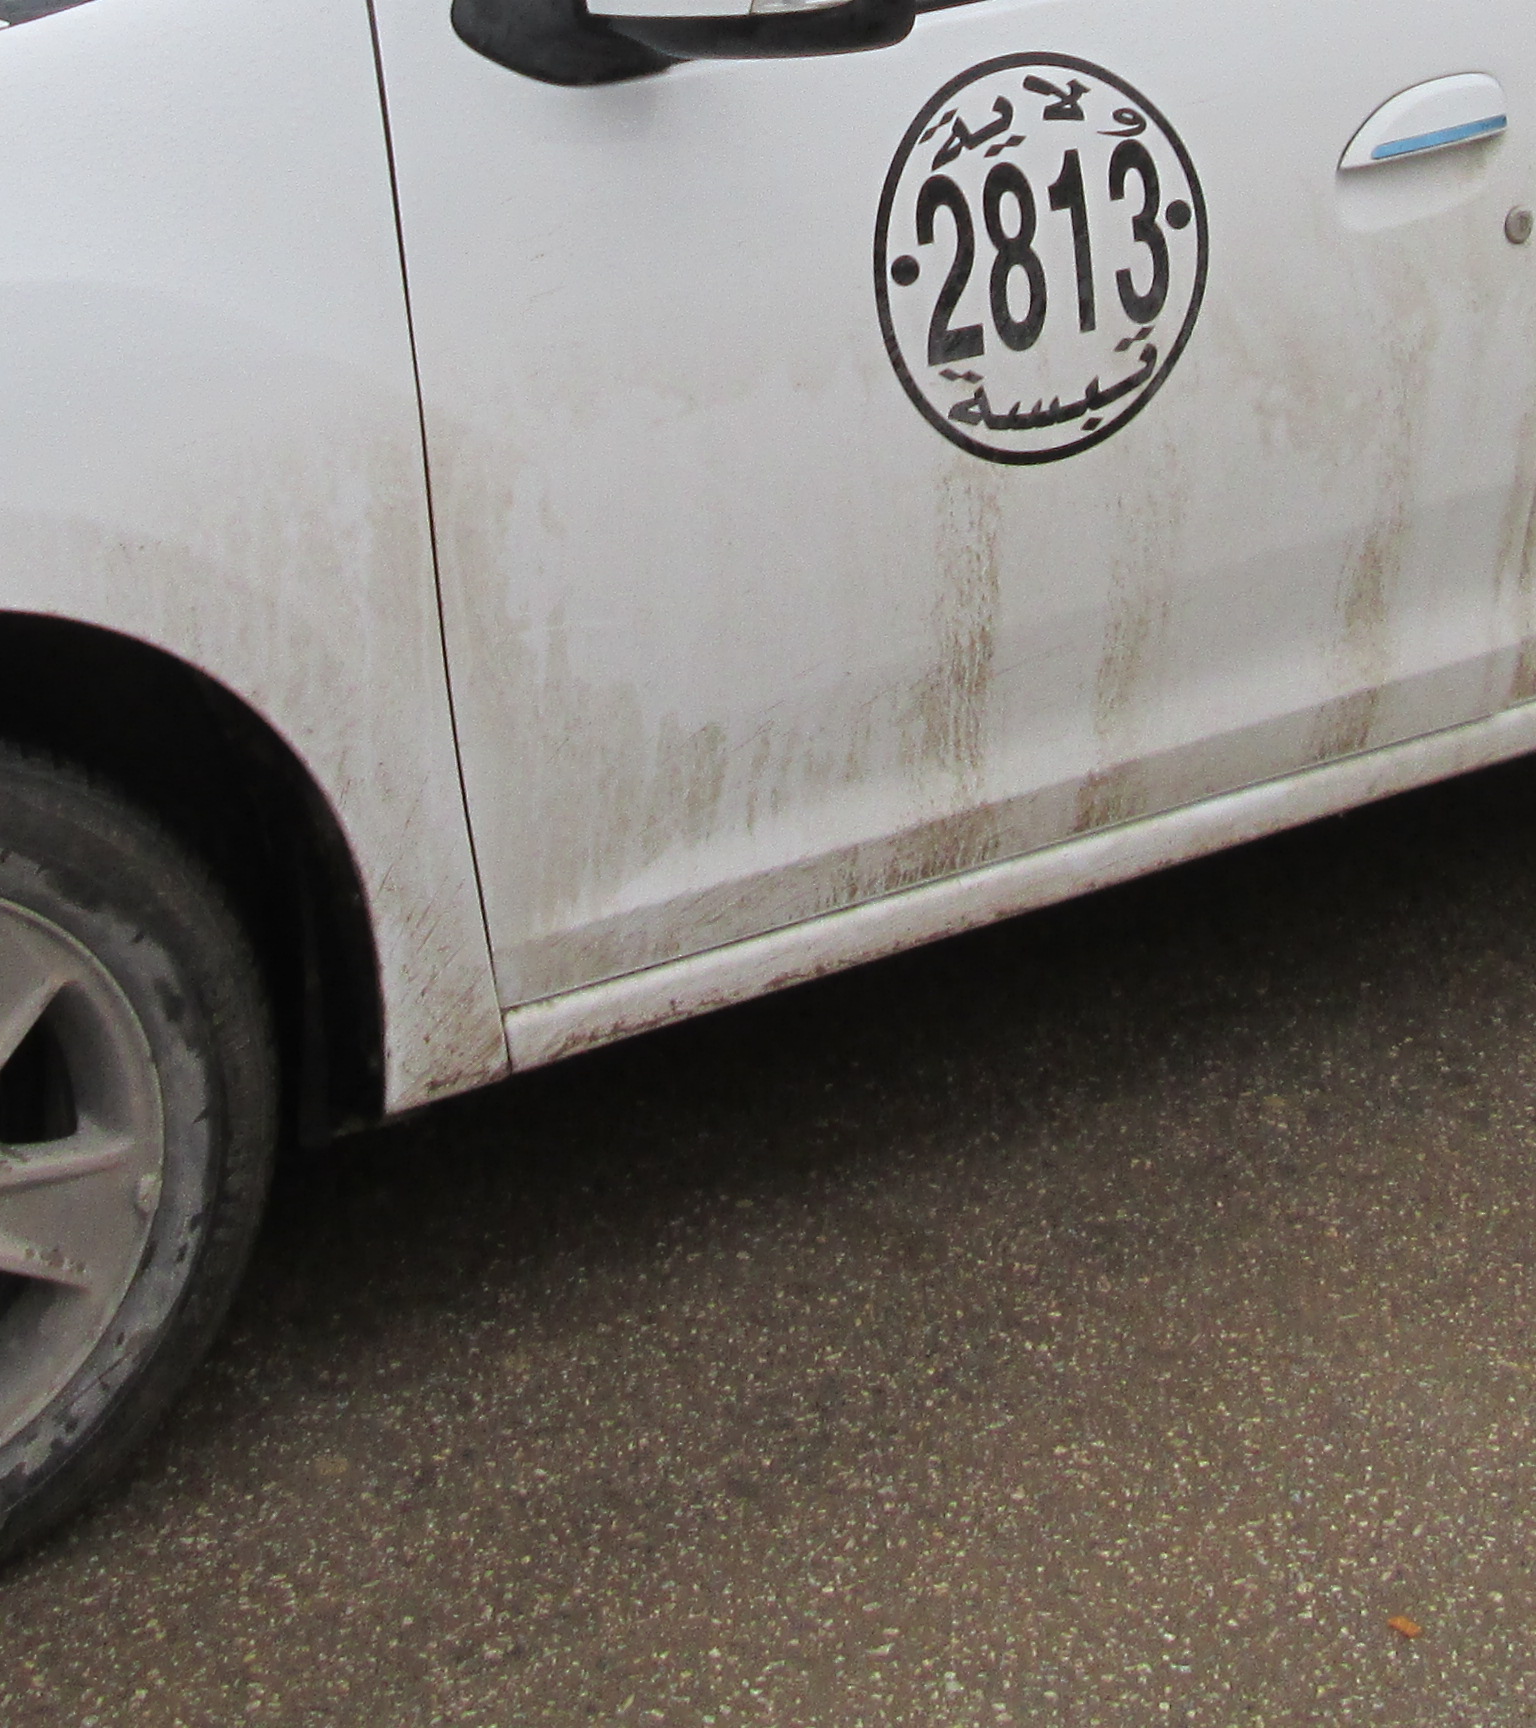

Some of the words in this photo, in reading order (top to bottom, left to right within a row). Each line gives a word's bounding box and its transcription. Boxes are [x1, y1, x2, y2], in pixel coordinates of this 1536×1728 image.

[918, 74, 1148, 172] ولاية
[915, 138, 1170, 367] 2813
[939, 326, 1158, 432] تبسة
